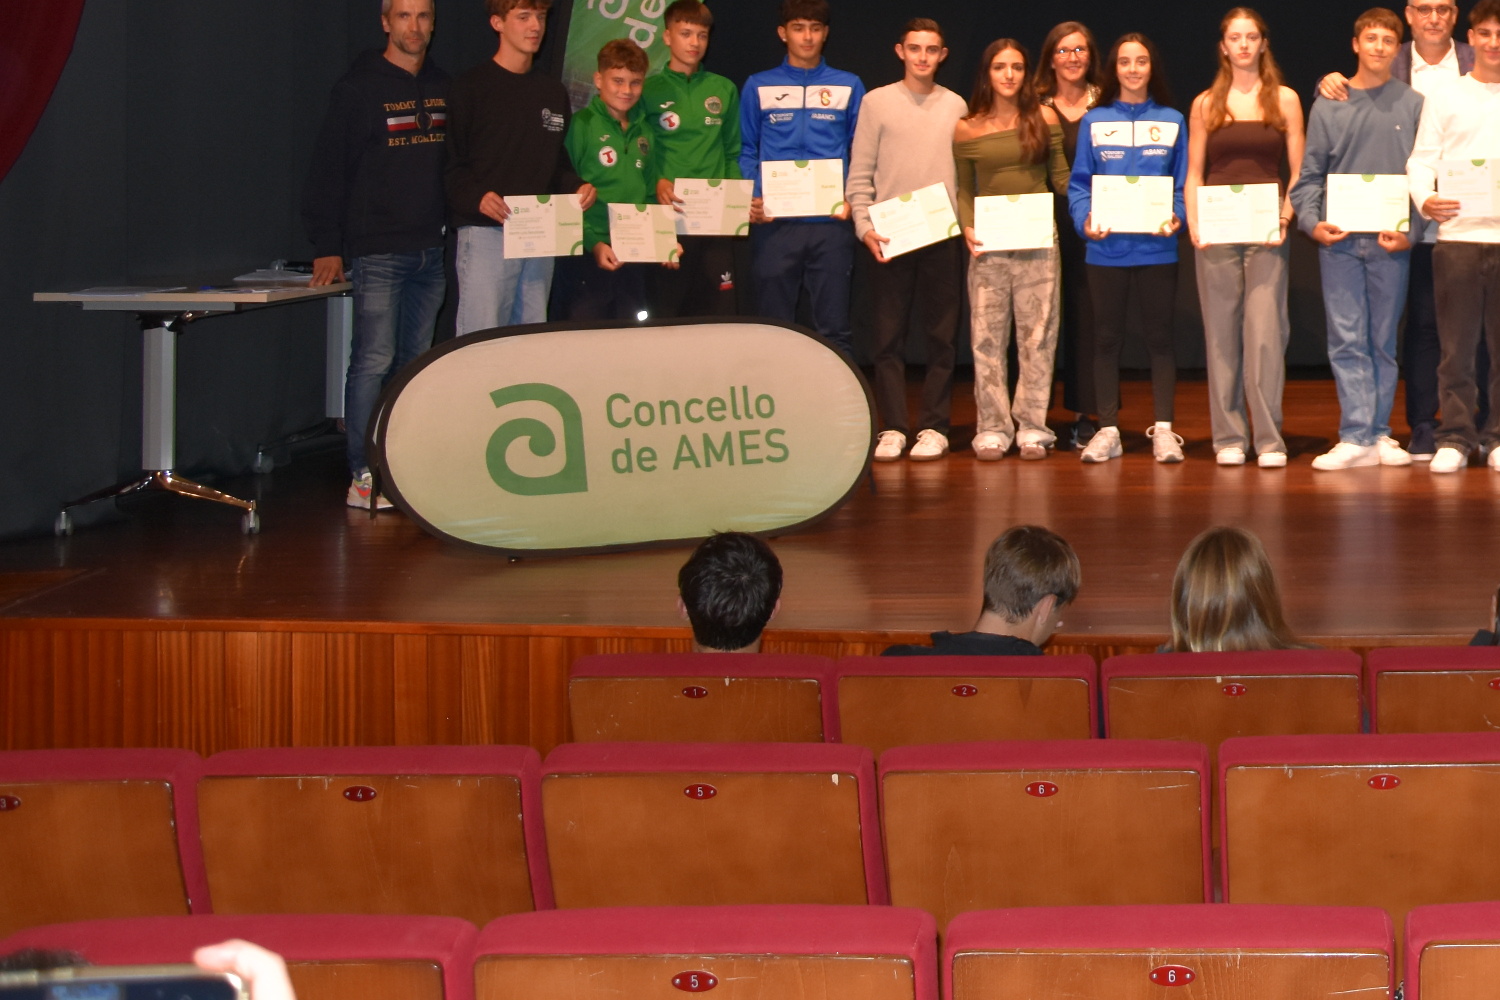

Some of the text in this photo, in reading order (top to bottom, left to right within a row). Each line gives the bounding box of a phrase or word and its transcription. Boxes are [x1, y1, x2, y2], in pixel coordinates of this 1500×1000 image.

[383, 101, 416, 111] TOMMY
[388, 137, 409, 147] EST.
[606, 385, 775, 428] Concello
[611, 427, 789, 474] de AMES
[962, 687, 967, 695] 2
[1381, 777, 1387, 787] 7
[357, 788, 362, 798] 4
[697, 786, 703, 797] 5
[1038, 784, 1044, 795] 6
[691, 974, 699, 988] 5
[1168, 969, 1176, 983] 6
